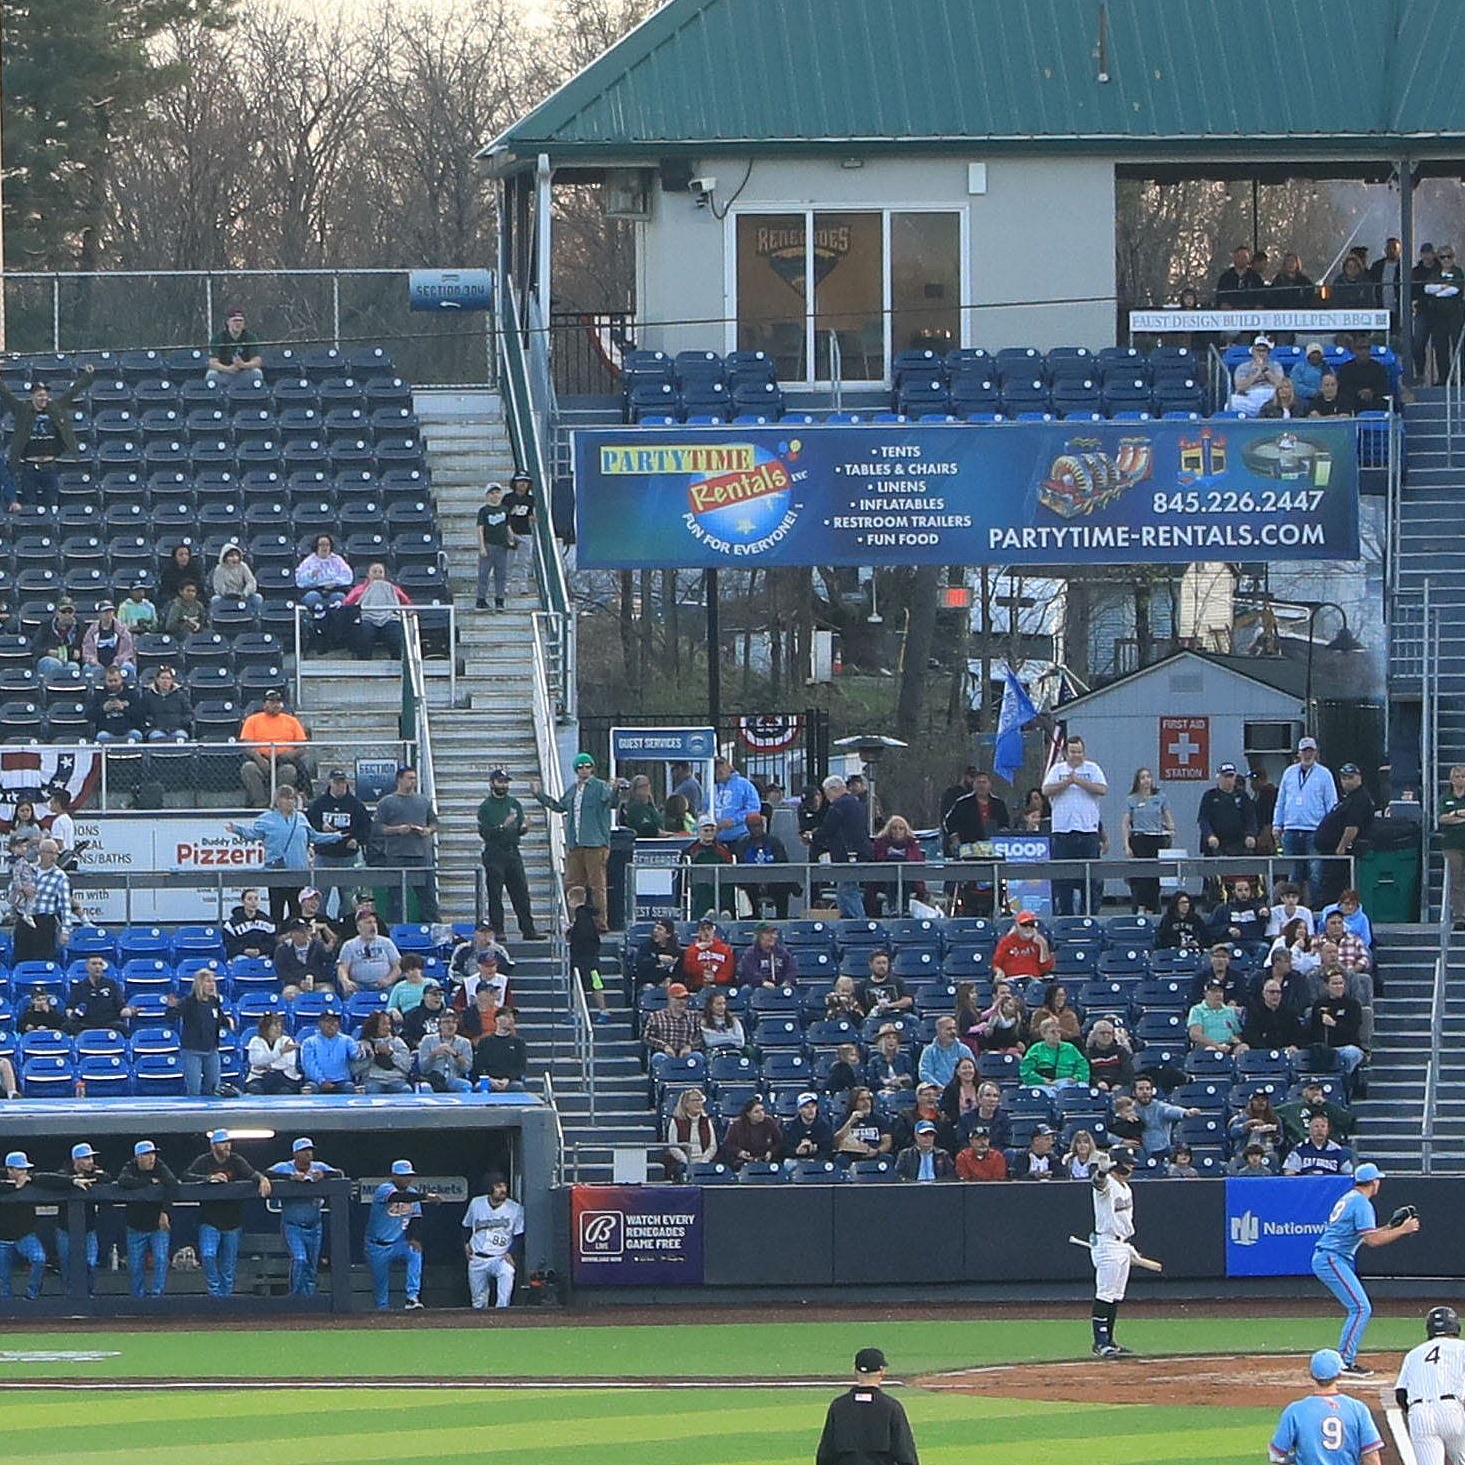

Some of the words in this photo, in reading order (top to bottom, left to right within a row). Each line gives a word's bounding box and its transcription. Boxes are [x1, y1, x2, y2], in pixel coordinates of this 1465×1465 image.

[1172, 315, 1219, 327] DESIGN
[1223, 315, 1261, 327] BUILD
[1273, 314, 1337, 327] BULLPEN
[1342, 313, 1371, 325] BBQ
[881, 445, 921, 458] TENTS
[602, 448, 753, 474] PARTYTIME
[845, 463, 892, 476] TABLES
[893, 463, 905, 476] &
[906, 463, 958, 475] CHAIRS
[691, 467, 788, 513] Rentals
[877, 480, 927, 493] LINENS
[859, 497, 945, 511] INFLATABLES
[1152, 490, 1325, 515] 845.226.2447
[833, 515, 909, 528] RESTROOM
[911, 515, 971, 528] TRAILERS
[682, 511, 705, 544] FUN
[704, 532, 731, 555] FOR
[867, 533, 896, 546] FUN
[898, 533, 939, 545] FOOD
[989, 524, 1325, 550] PARTYTIME-RENTALS.COM
[1163, 720, 1189, 730] FIRST
[1190, 720, 1206, 729] AID
[1165, 768, 1203, 778] STATION
[177, 843, 264, 866] Pizzeri
[994, 842, 1048, 858] SLOOP
[625, 1215, 661, 1225] WATCH
[662, 1215, 695, 1225] EVERY
[625, 1226, 686, 1238] RENEGADES
[1263, 1221, 1328, 1236] Nationwi
[625, 1239, 654, 1249] GAME
[656, 1239, 682, 1249] FREE
[1424, 1345, 1441, 1365] 4
[1321, 1415, 1344, 1452] 9
